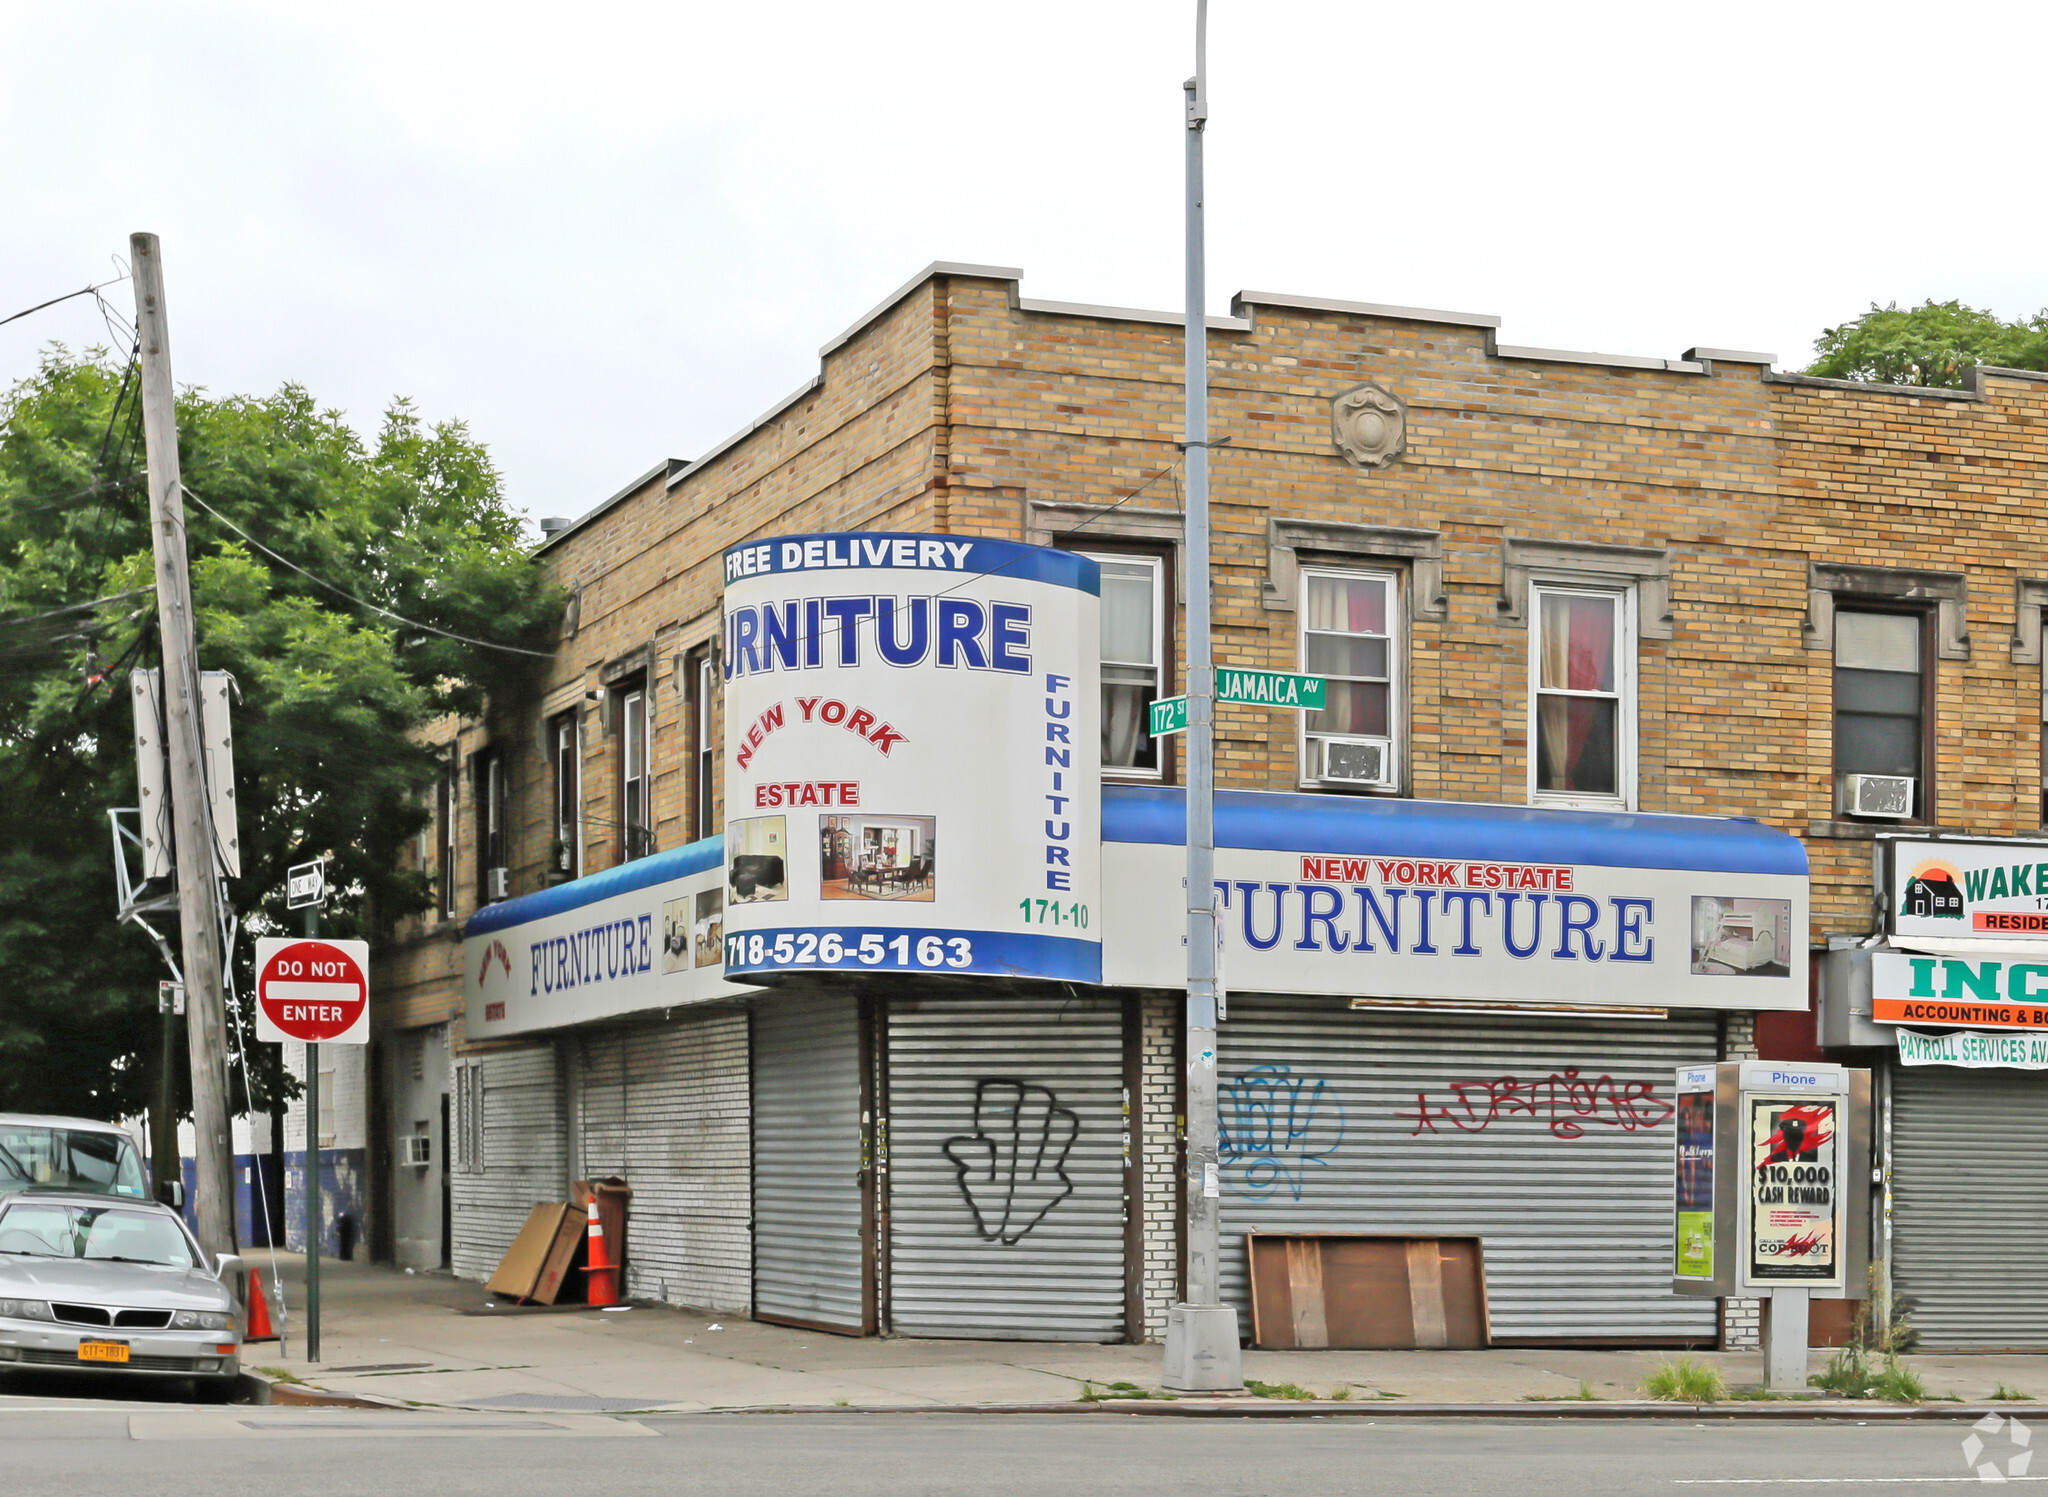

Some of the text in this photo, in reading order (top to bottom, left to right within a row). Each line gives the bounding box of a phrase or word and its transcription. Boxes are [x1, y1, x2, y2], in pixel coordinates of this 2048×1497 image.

[726, 539, 974, 582] FREE DELIVERY
[1219, 673, 1319, 703] JAMAICA AV
[1154, 701, 1186, 731] 172 ST
[736, 696, 910, 773] NEW YORK
[755, 780, 860, 809] ESTATE
[1045, 673, 1071, 892] FURNITURE
[292, 874, 319, 895] ONE WAY
[1300, 855, 1574, 891] NEW YORK ESTATE
[1964, 863, 2048, 902] WAKE
[1019, 898, 1089, 929] 171-10
[530, 912, 652, 997] FURNITURE
[728, 933, 973, 968] 718-526-5163
[278, 960, 347, 977] DO NOT
[283, 1005, 343, 1022] ENTER
[1904, 1004, 2011, 1023] ACCOUNTING
[2017, 1010, 2027, 1023] &
[1900, 1035, 1957, 1061] PAYROLL
[1963, 1038, 2026, 1063] SERVICES
[1687, 1072, 1706, 1083] Phone
[1772, 1072, 1816, 1085] Phone
[1758, 1166, 1830, 1186] $10,000
[1758, 1186, 1830, 1204] CASH REWARD
